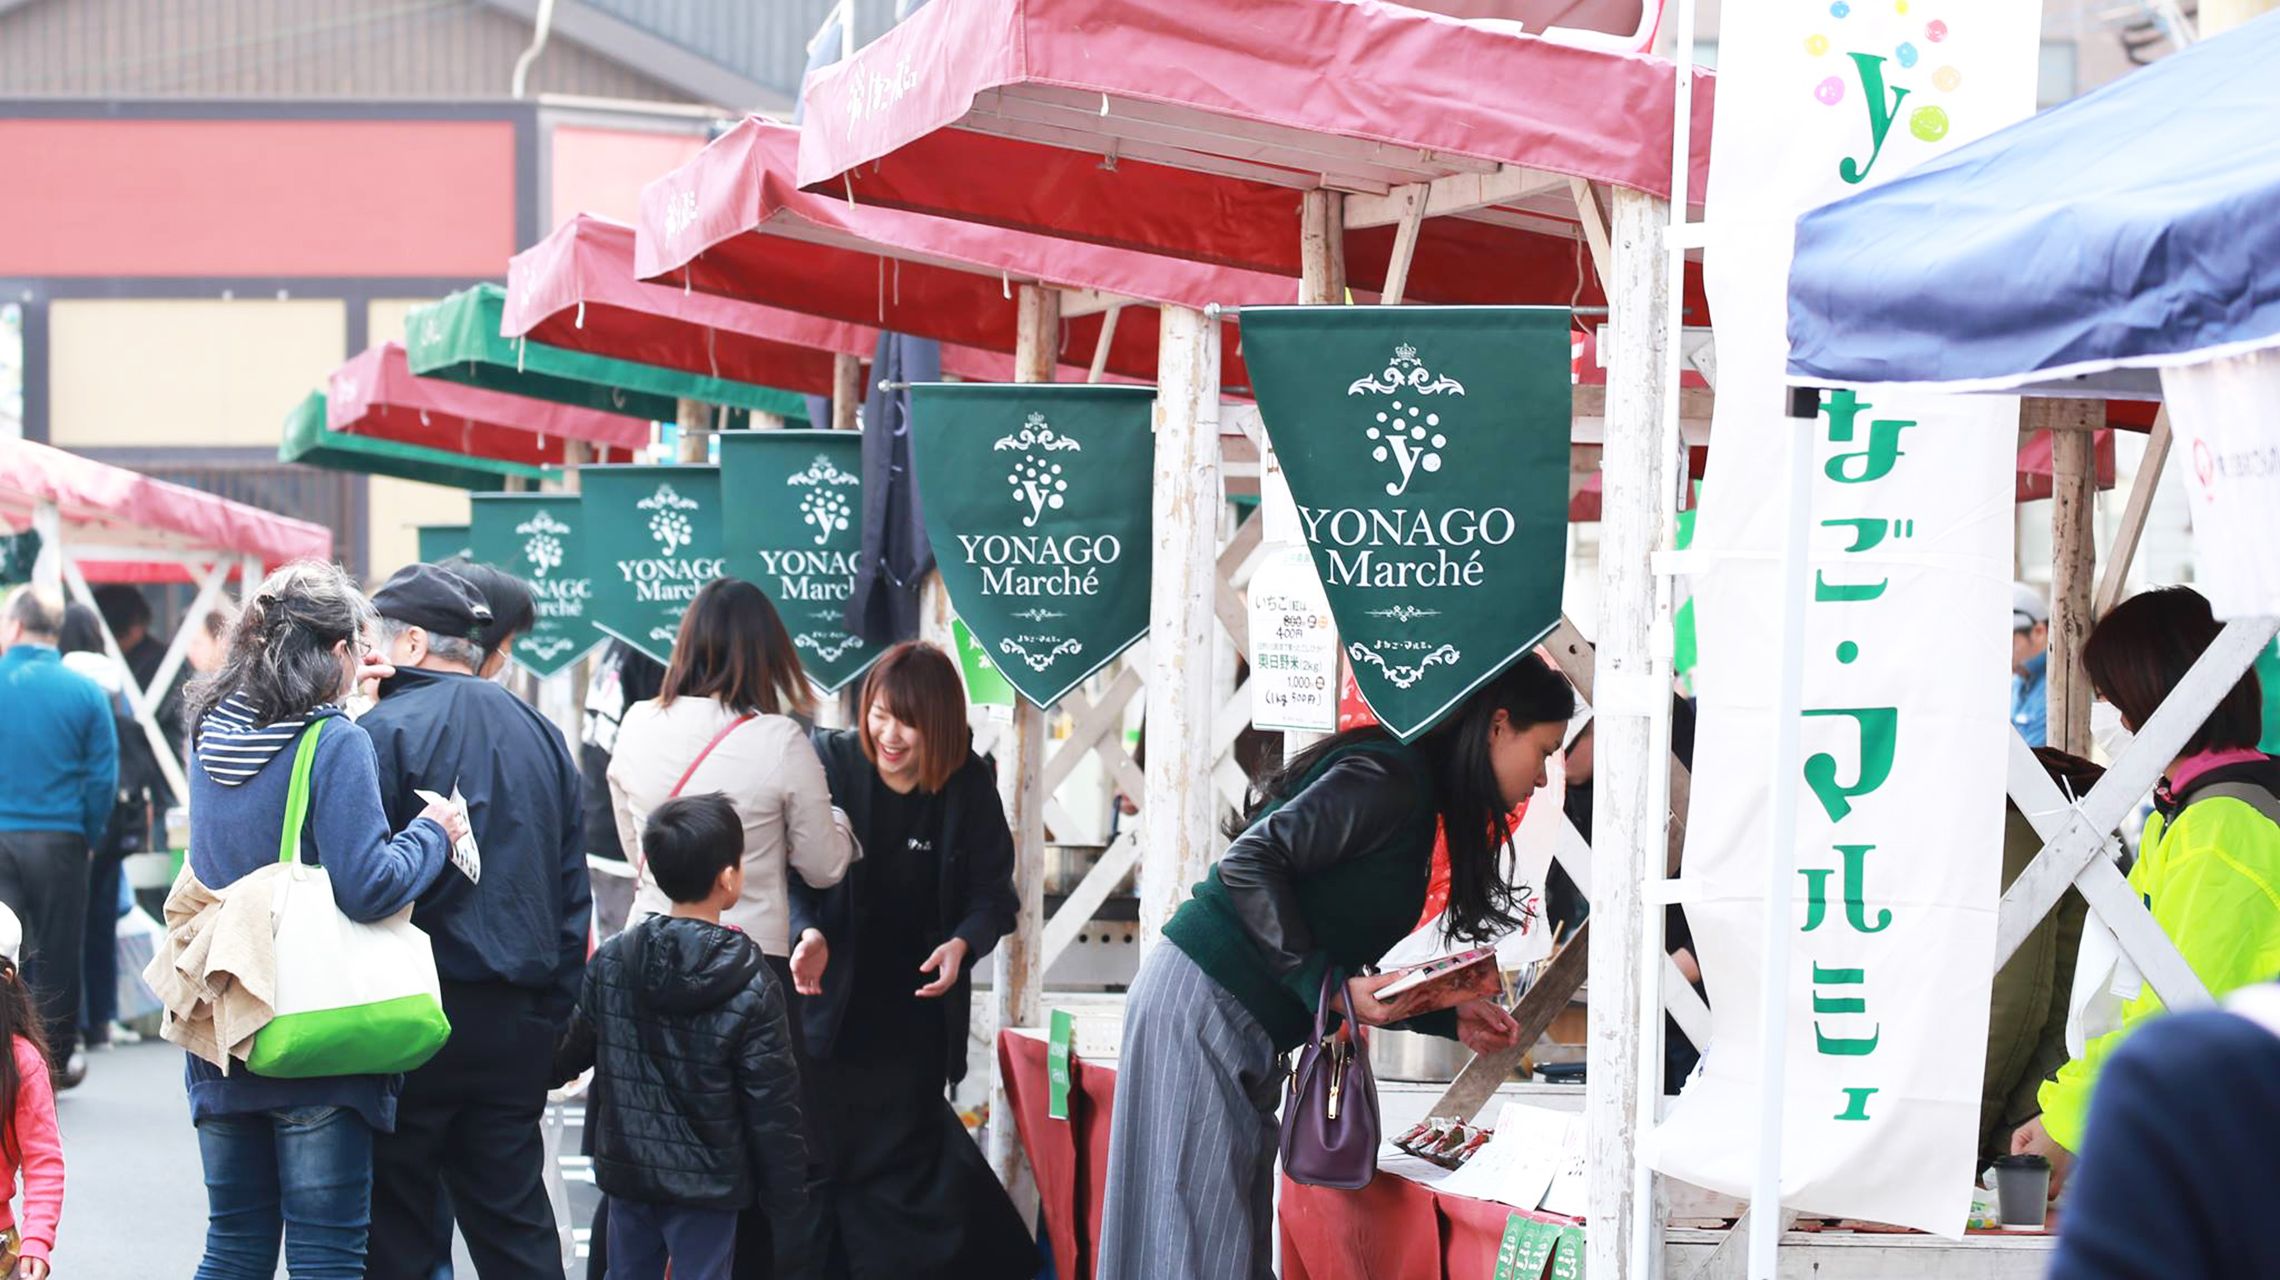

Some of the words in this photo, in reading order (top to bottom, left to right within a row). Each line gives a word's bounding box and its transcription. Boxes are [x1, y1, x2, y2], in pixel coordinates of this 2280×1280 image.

[1840, 52, 1911, 185] y
[1386, 434, 1423, 496] y
[1022, 480, 1049, 527] y
[812, 507, 836, 545] y
[1298, 505, 1515, 546] YONAGO
[957, 534, 1121, 565] YONAGO
[1325, 549, 1484, 587] Marché
[980, 566, 1099, 595] Marché
